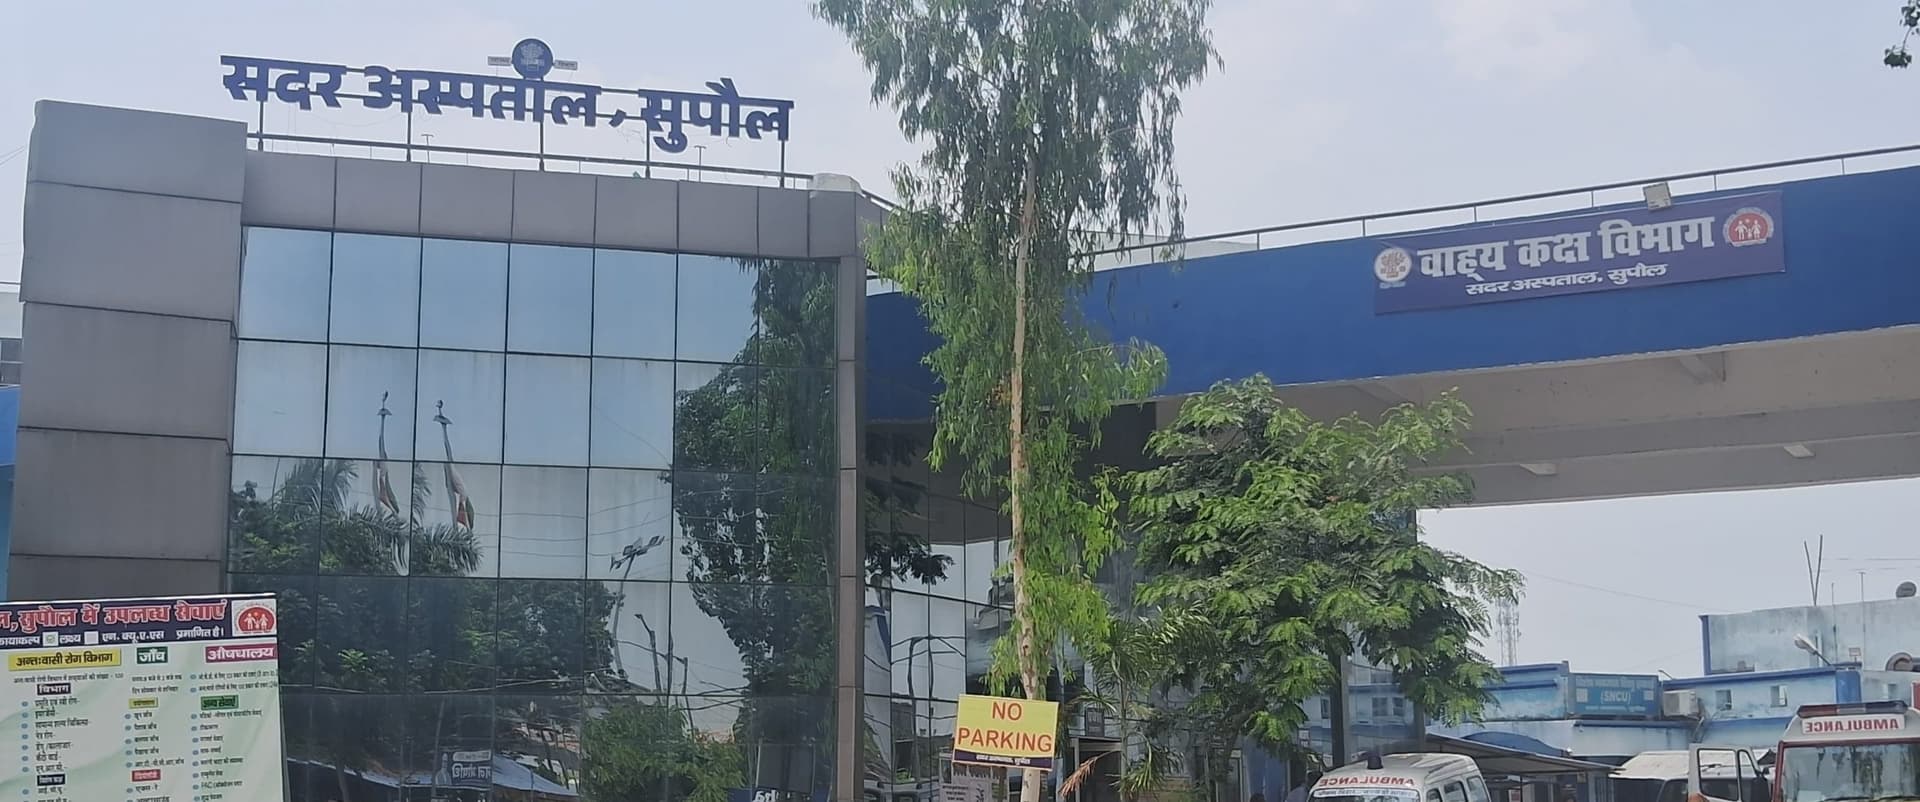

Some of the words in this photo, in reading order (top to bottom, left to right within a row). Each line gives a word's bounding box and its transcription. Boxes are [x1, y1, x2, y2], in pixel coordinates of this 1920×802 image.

[221, 55, 346, 111] सदर
[638, 78, 794, 153] सुपौल
[1514, 232, 1591, 268] कक्ष
[1597, 218, 1715, 260] विभाग
[1466, 281, 1510, 295] सदर
[82, 604, 100, 625] में
[103, 606, 171, 625] उपलब्ध
[64, 652, 82, 664] रोग
[83, 651, 113, 663] विभाग
[992, 702, 1022, 721] NO
[958, 727, 1052, 752] PARKING
